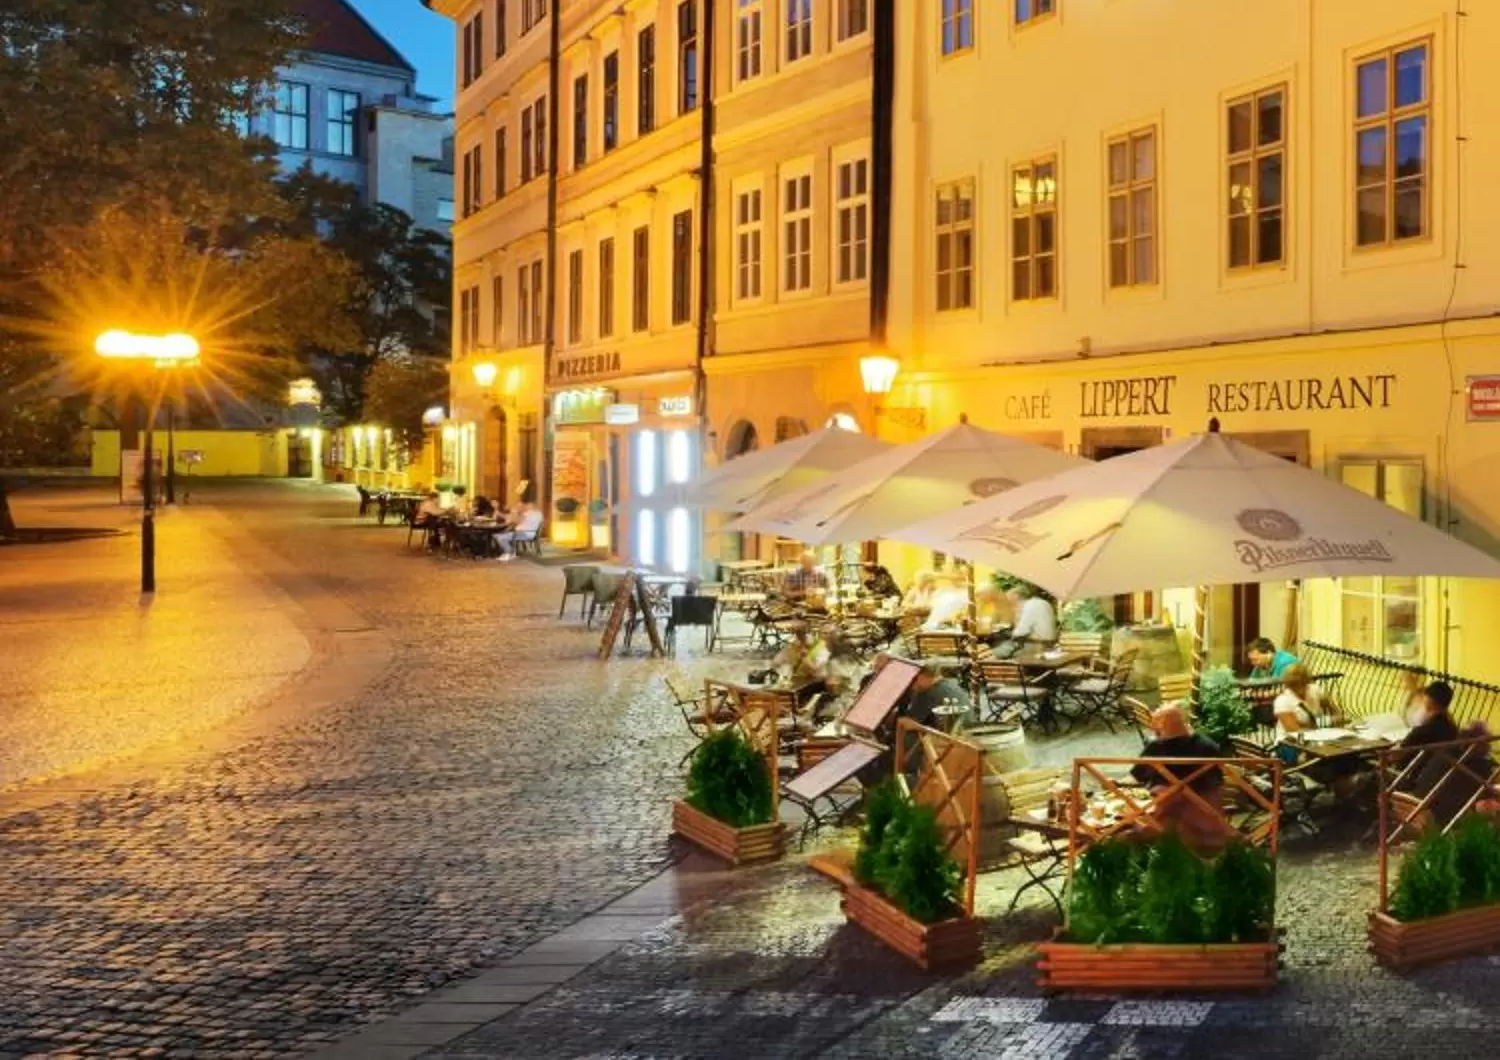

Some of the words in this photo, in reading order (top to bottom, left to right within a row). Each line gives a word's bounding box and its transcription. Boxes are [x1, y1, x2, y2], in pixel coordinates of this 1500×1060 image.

[557, 352, 621, 377] PIZZERIA
[1004, 388, 1053, 421] CAFÉ
[1080, 375, 1177, 417] LIPPERT
[1207, 374, 1396, 413] RESTAURANT
